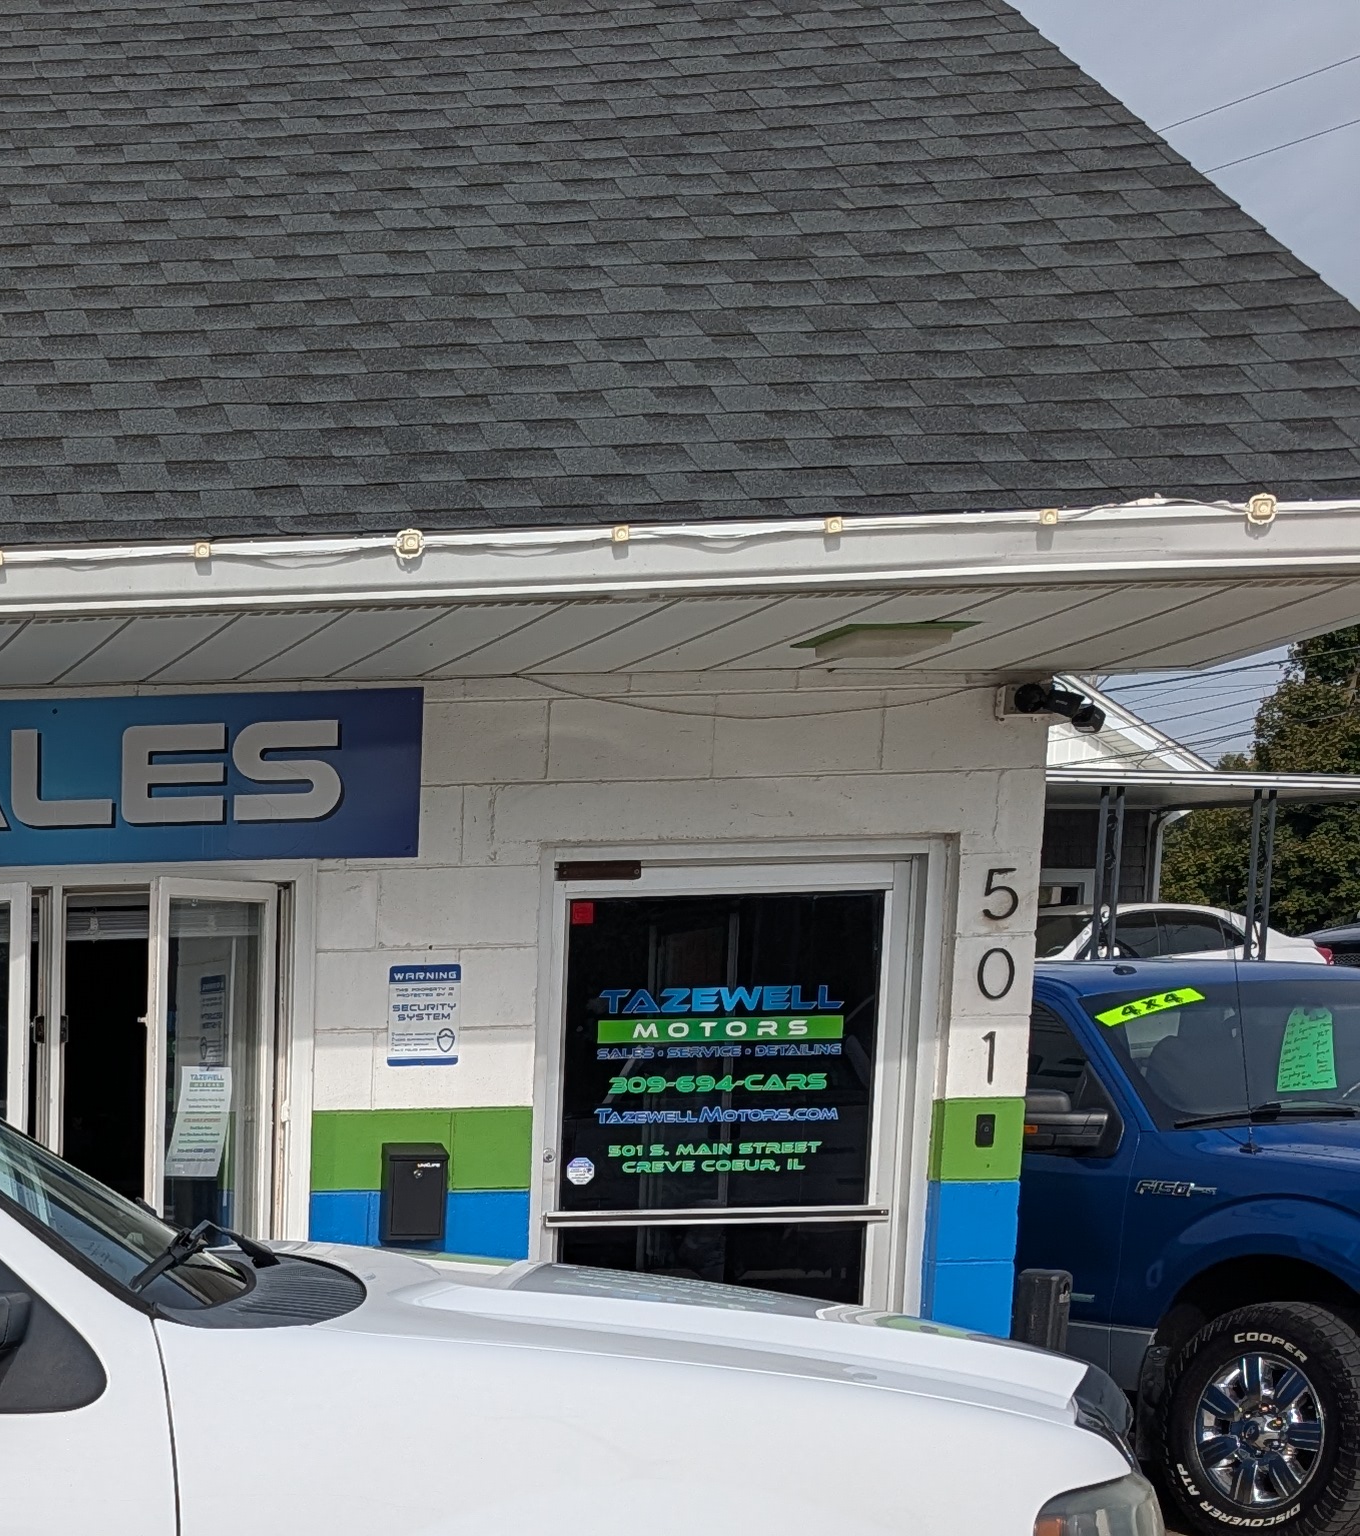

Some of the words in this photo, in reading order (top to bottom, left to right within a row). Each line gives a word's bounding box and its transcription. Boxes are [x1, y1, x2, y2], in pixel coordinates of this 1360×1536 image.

[393, 971, 457, 980] WARNING
[392, 1003, 457, 1012] SECURITY
[599, 985, 844, 1014] TAZEWELL
[397, 1012, 451, 1021] SYSTEM
[632, 1019, 808, 1039] MOTORS
[597, 1046, 655, 1060] SALES
[666, 1045, 742, 1058] SERVICE
[754, 1043, 842, 1057] DETAILING
[608, 1072, 827, 1094] 309-694-CARS
[608, 1144, 644, 1157] 501
[649, 1144, 670, 1156] S.
[676, 1143, 732, 1155] MAIN
[738, 1141, 822, 1154] STREET
[622, 1159, 696, 1173] CREVE
[701, 1158, 780, 1172] COEUR,
[787, 1158, 806, 1171] IL
[1233, 1331, 1308, 1364] COOPER
[1199, 1500, 1301, 1528] DISCOVERER
